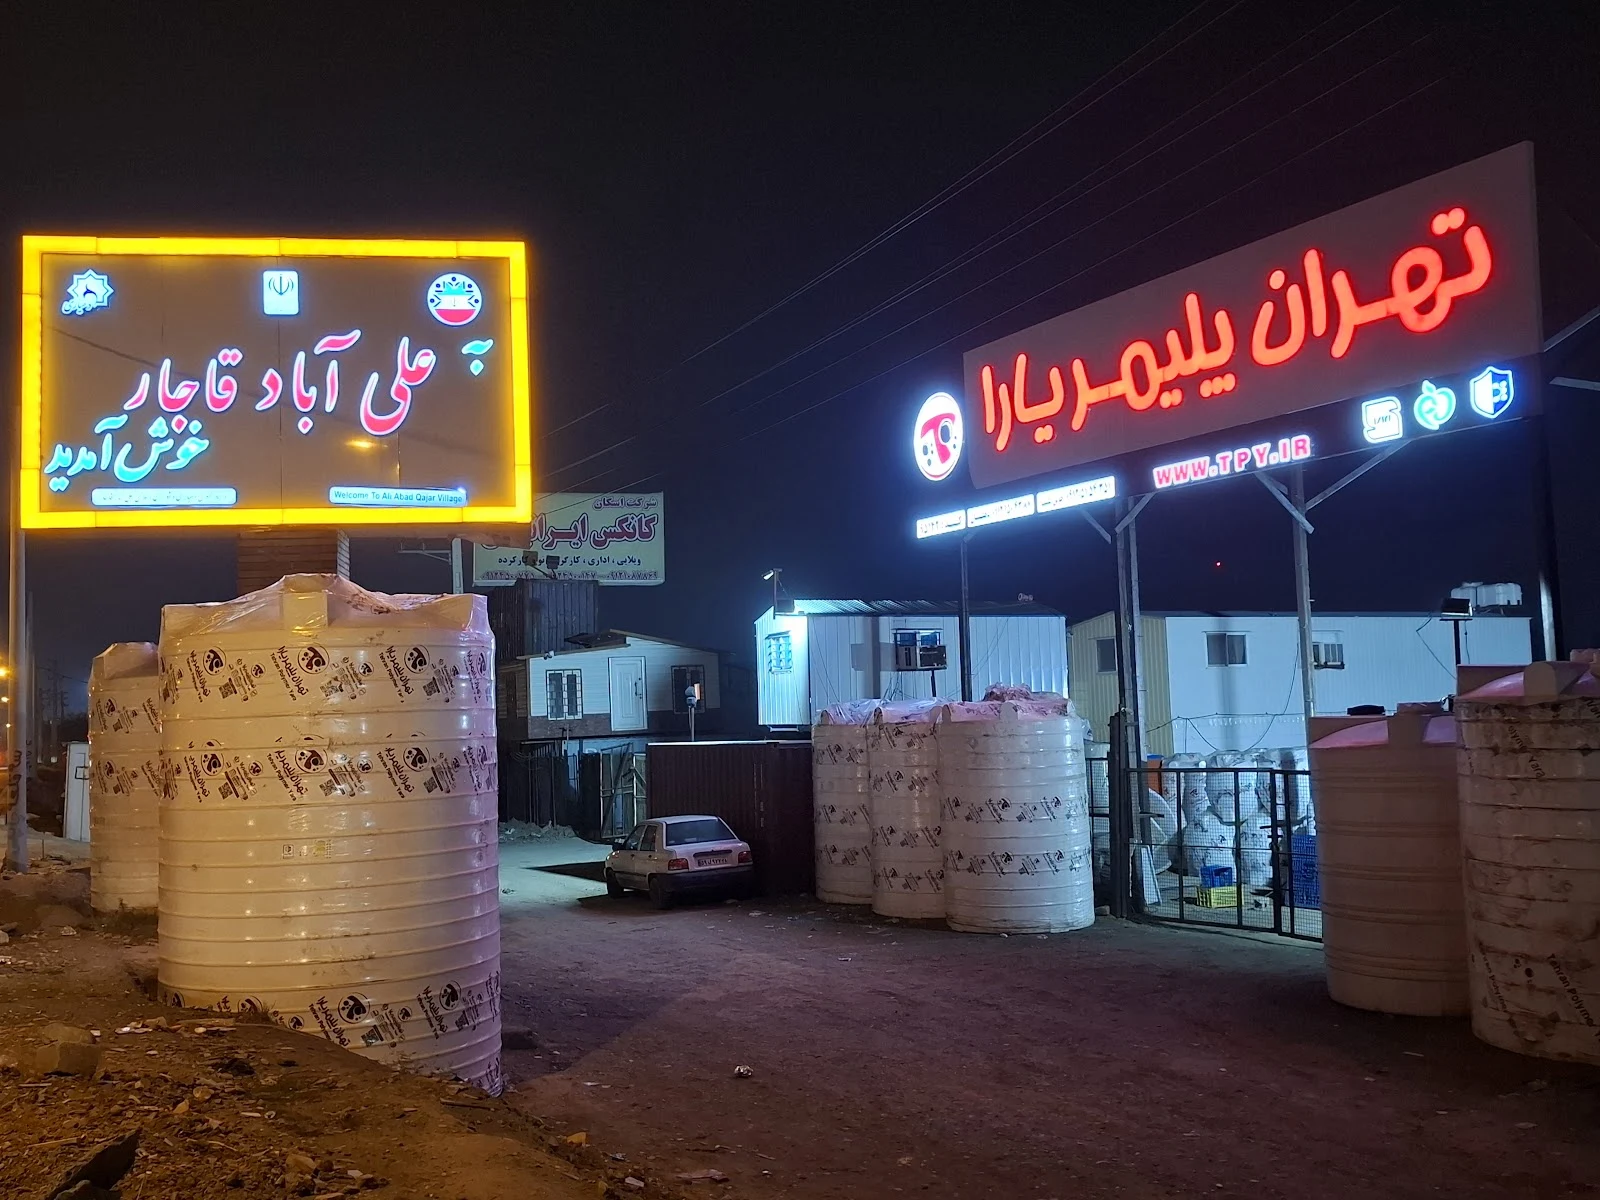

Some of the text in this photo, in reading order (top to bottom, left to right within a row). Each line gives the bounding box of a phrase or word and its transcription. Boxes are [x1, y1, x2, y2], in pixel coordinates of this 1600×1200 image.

[981, 207, 1492, 451] تهران پلیمر یارا
[123, 329, 437, 436] علی آباد قاجار
[43, 413, 210, 492] خوش آمدید
[1154, 436, 1310, 487] WWW.TPY.IR
[334, 490, 463, 503] Welcome To Ali Abad Qajar Village
[592, 496, 657, 510] شرکت اسکان
[590, 513, 659, 550] کانکس
[588, 555, 610, 566] اداری
[1547, 953, 1571, 988] Tehran
